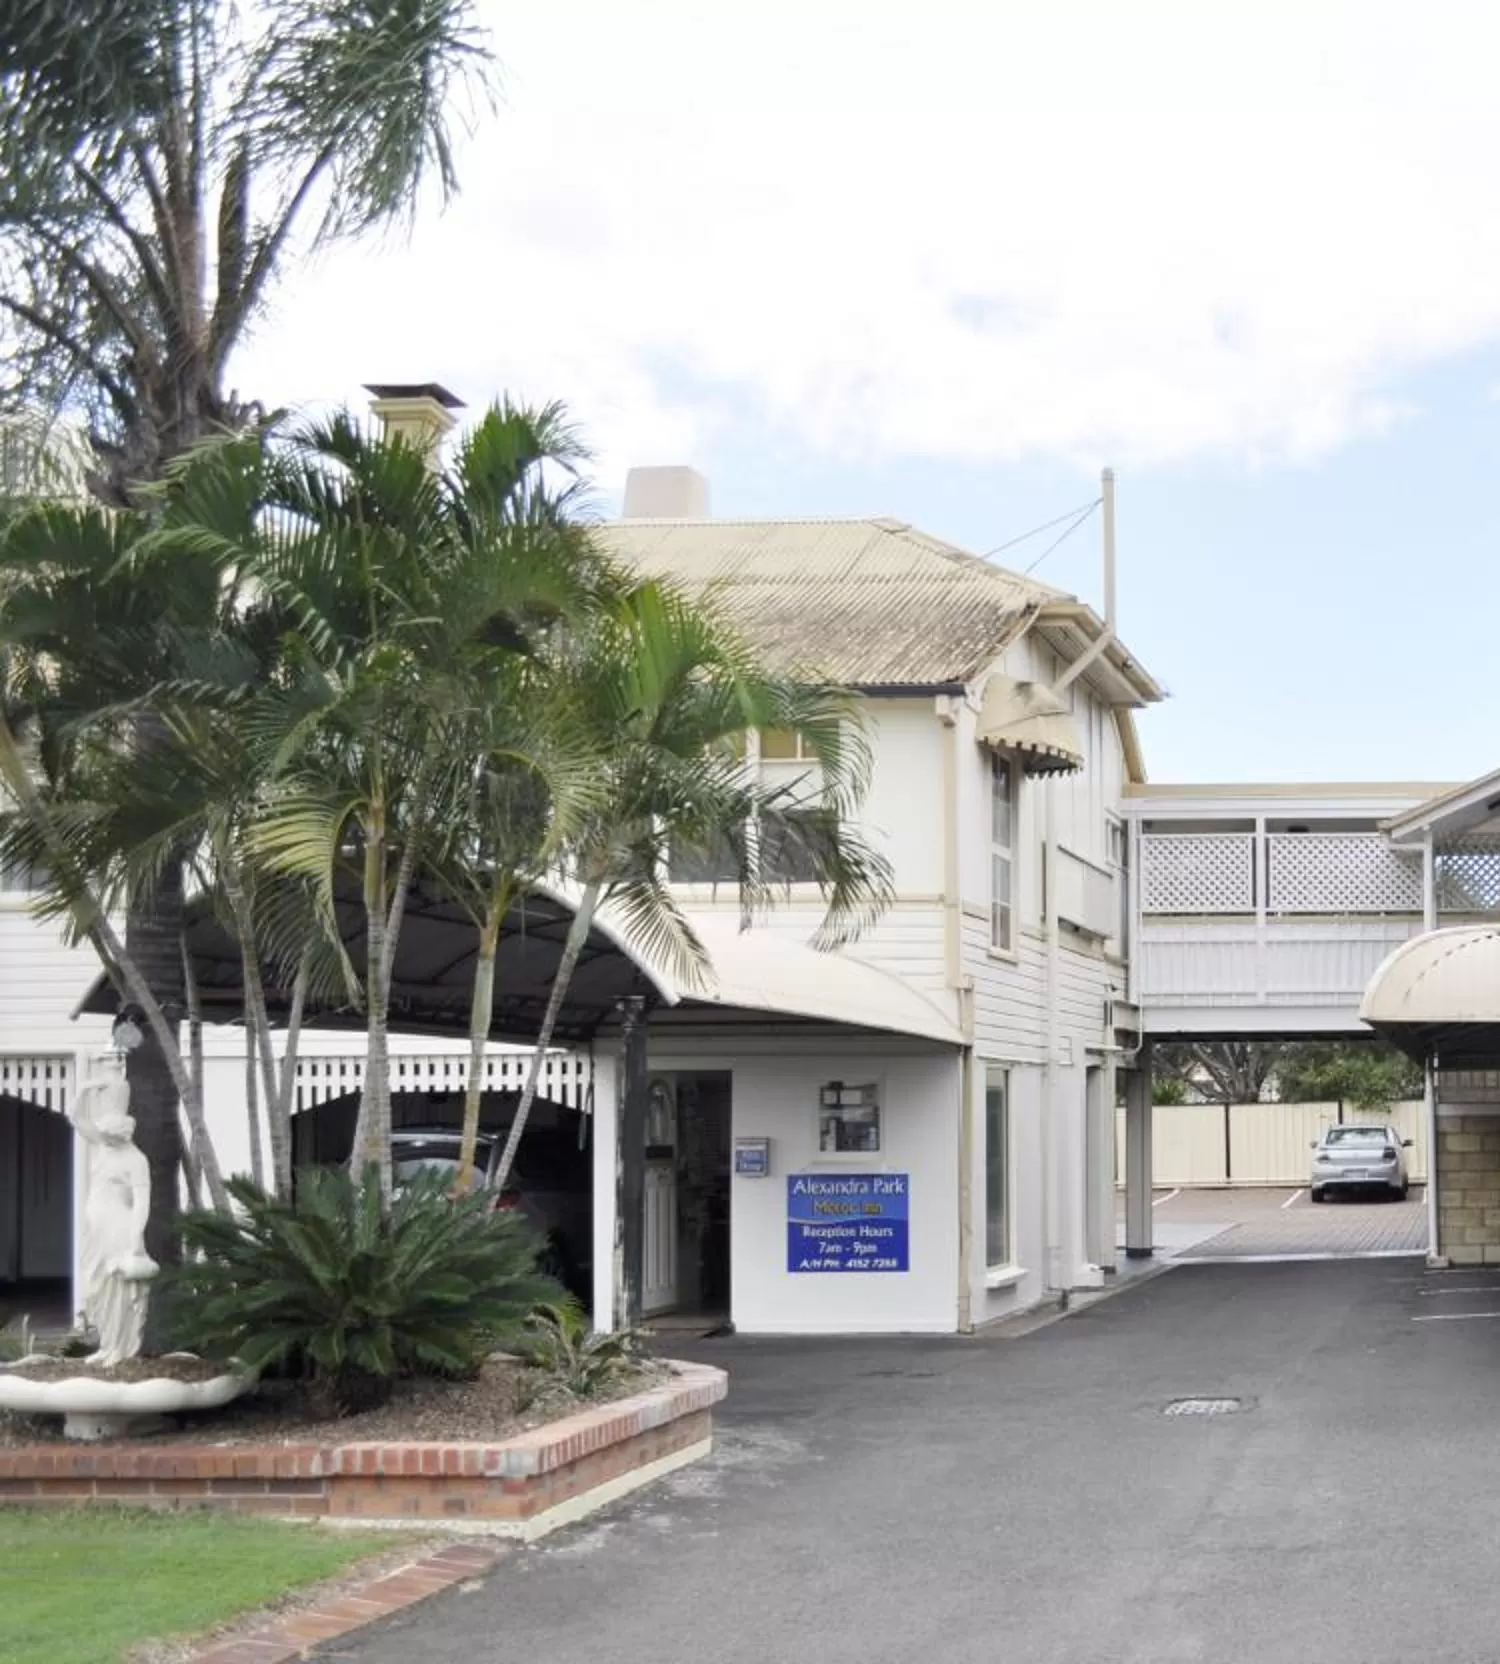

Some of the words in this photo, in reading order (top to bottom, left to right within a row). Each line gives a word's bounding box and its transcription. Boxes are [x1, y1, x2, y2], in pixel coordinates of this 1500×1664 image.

[793, 1178, 868, 1195] Alexandra
[873, 1178, 904, 1195] Park
[859, 1225, 894, 1237] Hours
[818, 1242, 841, 1254] 7am
